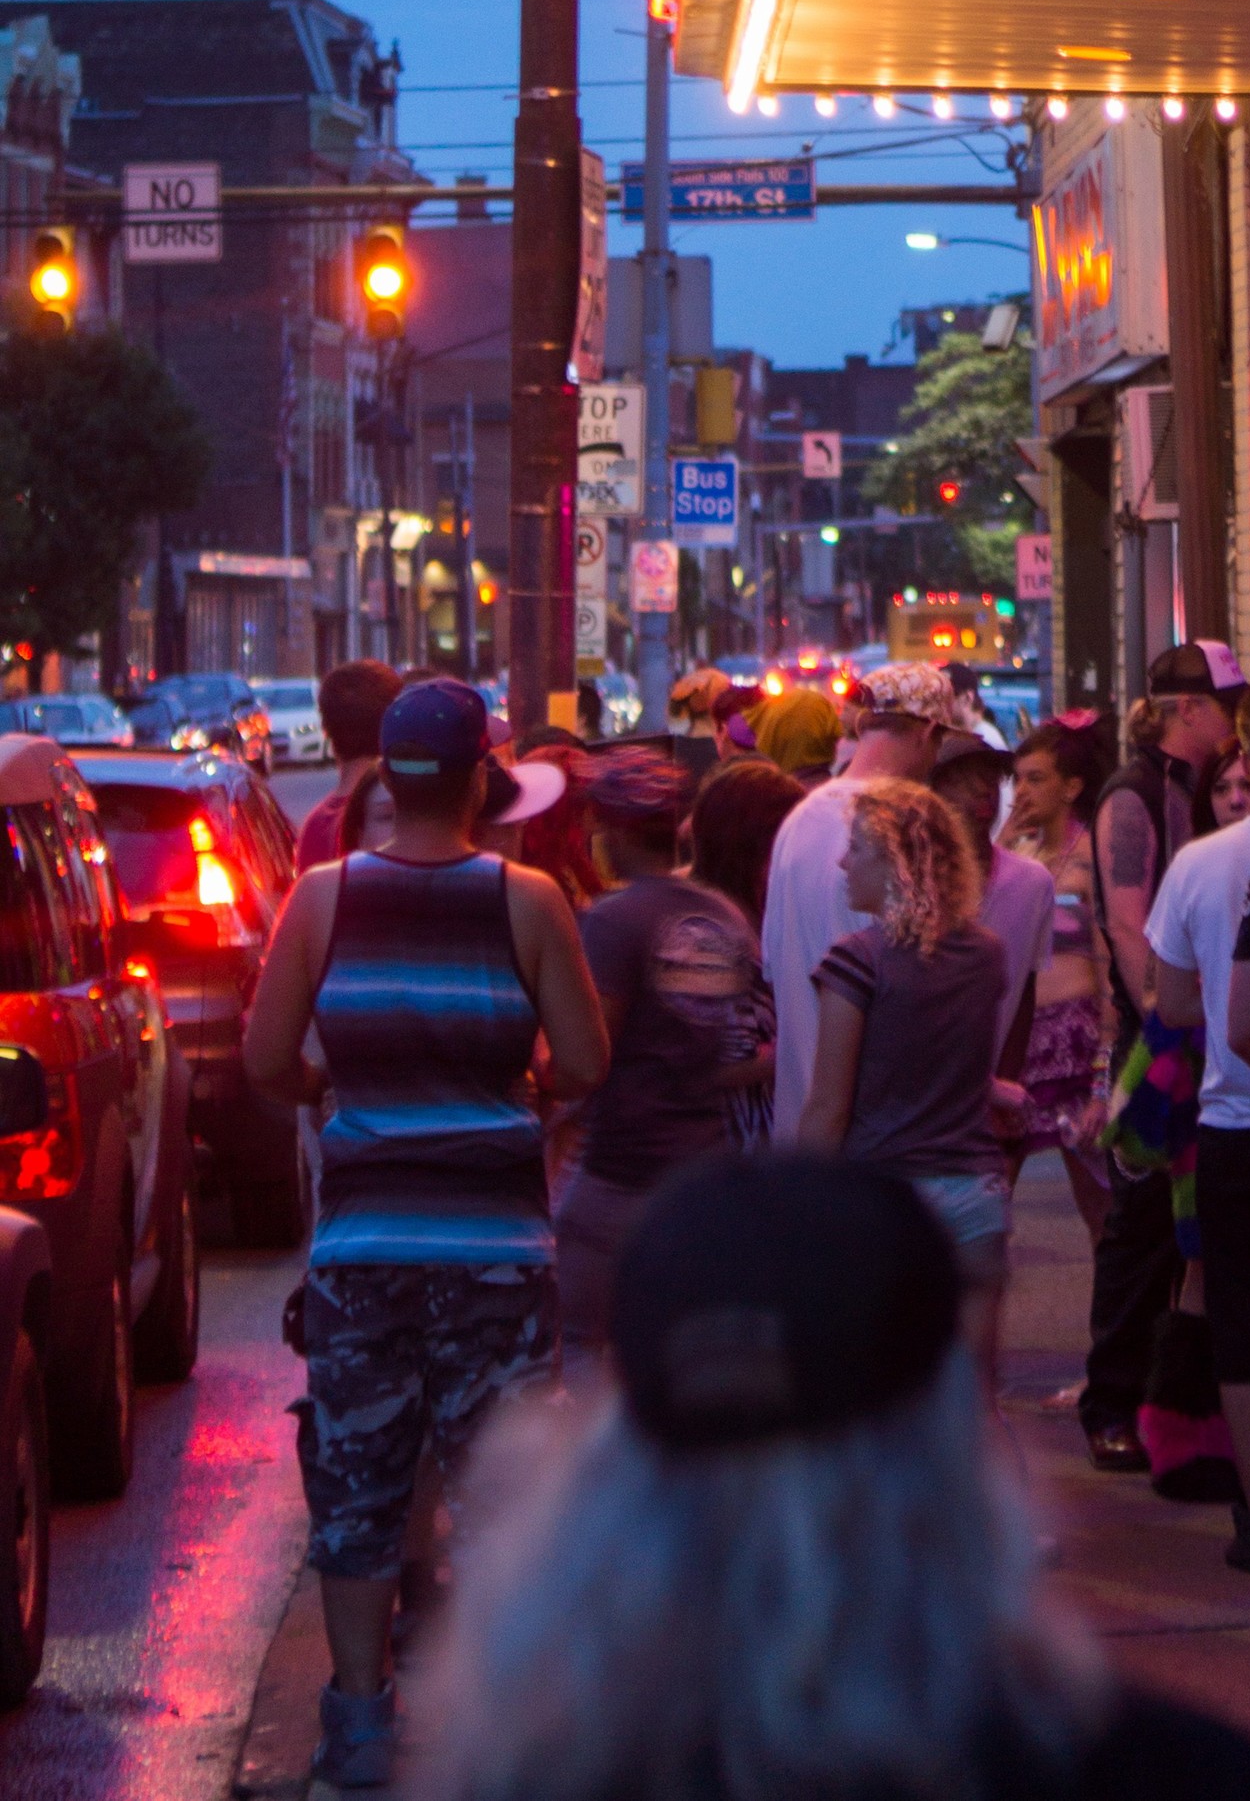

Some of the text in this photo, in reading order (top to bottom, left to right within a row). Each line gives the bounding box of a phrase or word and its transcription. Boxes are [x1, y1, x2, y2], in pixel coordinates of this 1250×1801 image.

[149, 178, 195, 211] NO
[686, 187, 786, 214] 17th St
[133, 222, 214, 248] TURNS
[579, 396, 628, 420] TOP
[582, 425, 613, 440] ERE
[682, 464, 728, 491] Bus
[676, 491, 733, 520] Stop
